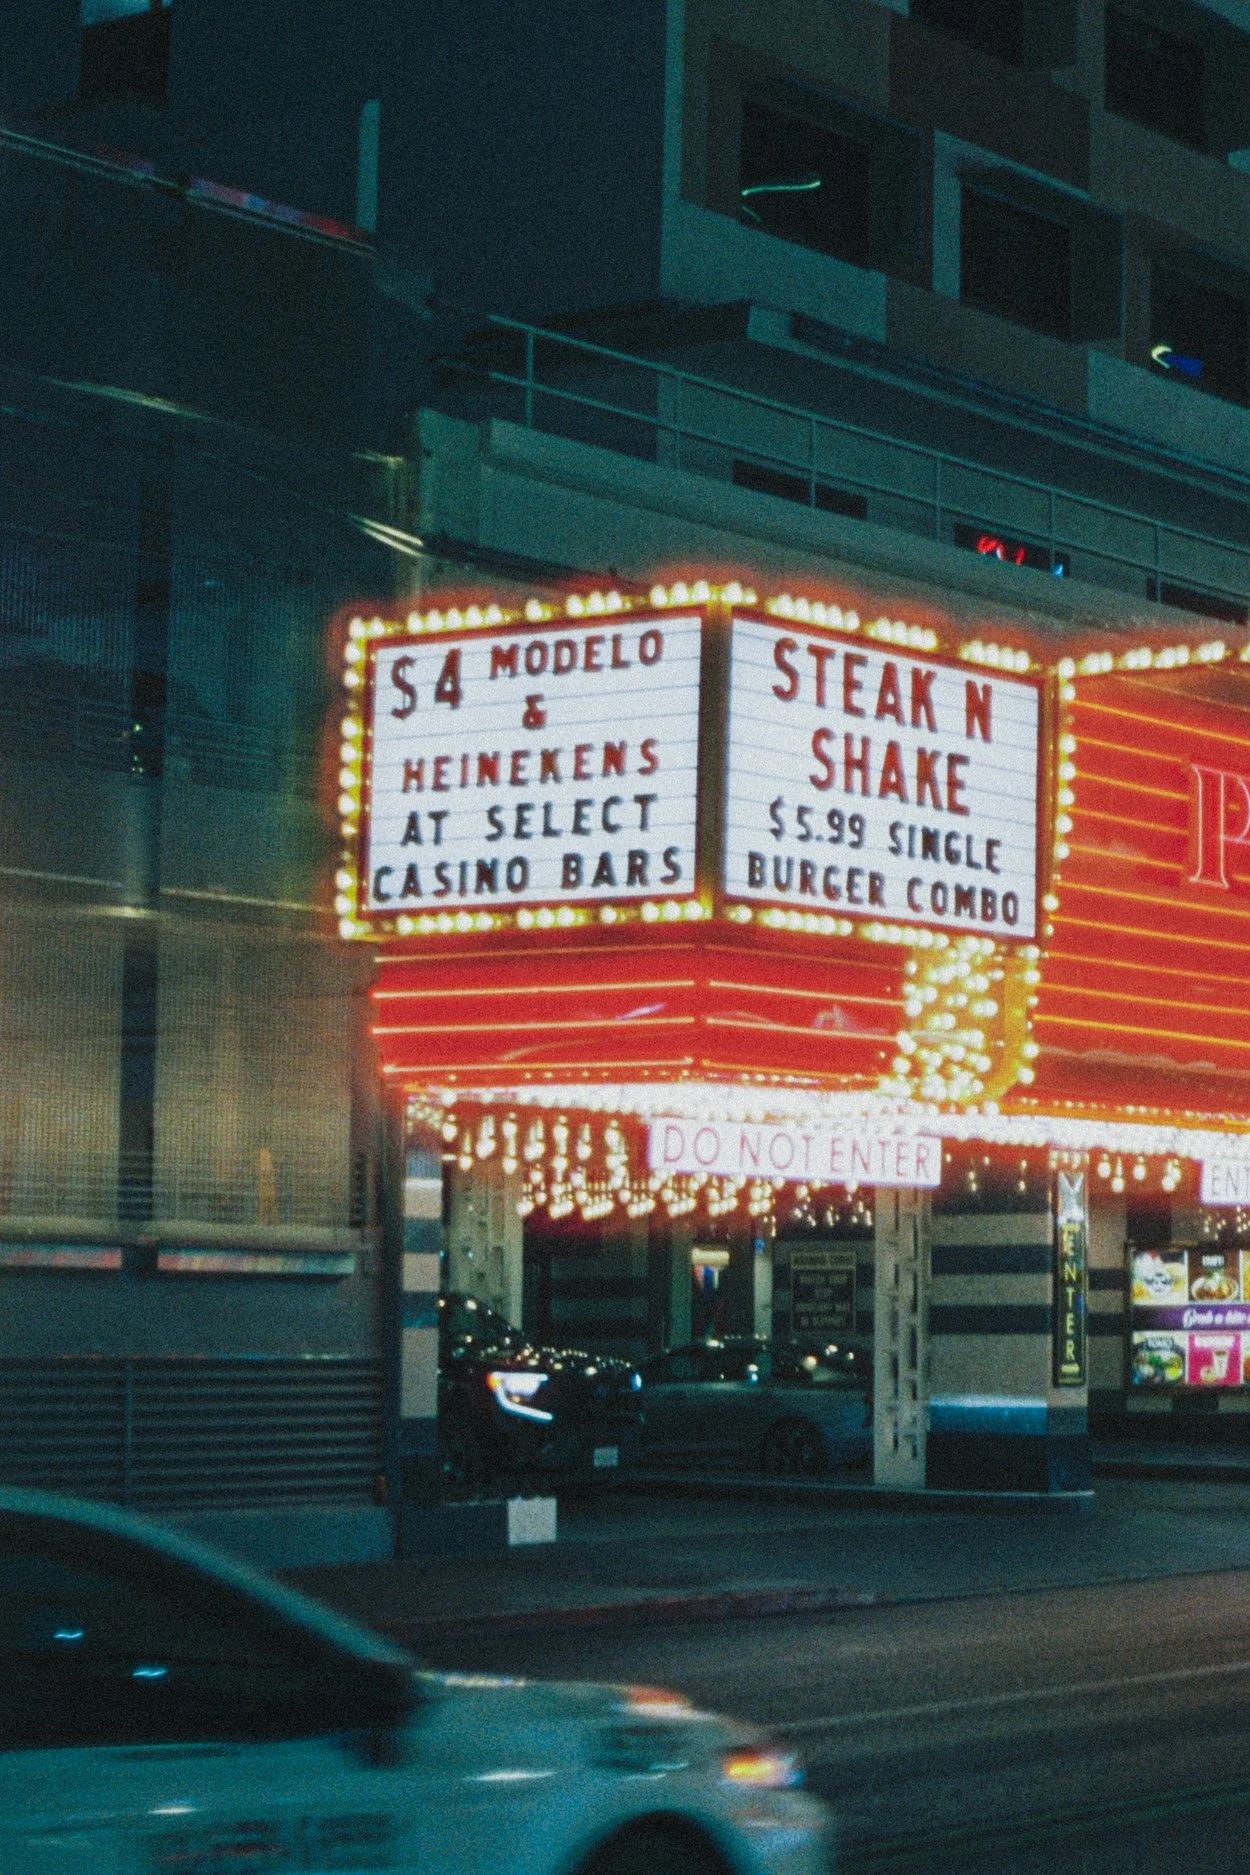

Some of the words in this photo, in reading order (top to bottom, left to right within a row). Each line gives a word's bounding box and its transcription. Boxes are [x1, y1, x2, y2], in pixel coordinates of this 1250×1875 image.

[390, 648, 463, 720] $4
[488, 628, 665, 681] MODELO
[521, 693, 548, 730] &
[771, 636, 939, 734] STEAK
[964, 679, 993, 744] N
[402, 737, 660, 794] HEINEKENS
[808, 726, 971, 817] SHAKE
[401, 809, 449, 847] AT
[484, 792, 659, 842] SELECT
[768, 795, 867, 850] $5.99
[888, 820, 1001, 875] SINGLE
[372, 855, 530, 903] CASINO
[560, 845, 684, 891] BARS
[747, 851, 887, 909] BURGER
[906, 876, 1020, 927] COMBO
[663, 1124, 721, 1166] DO
[739, 1130, 814, 1171] NOT
[830, 1136, 931, 1179] ENTER
[1063, 1232, 1077, 1362] ENTER
